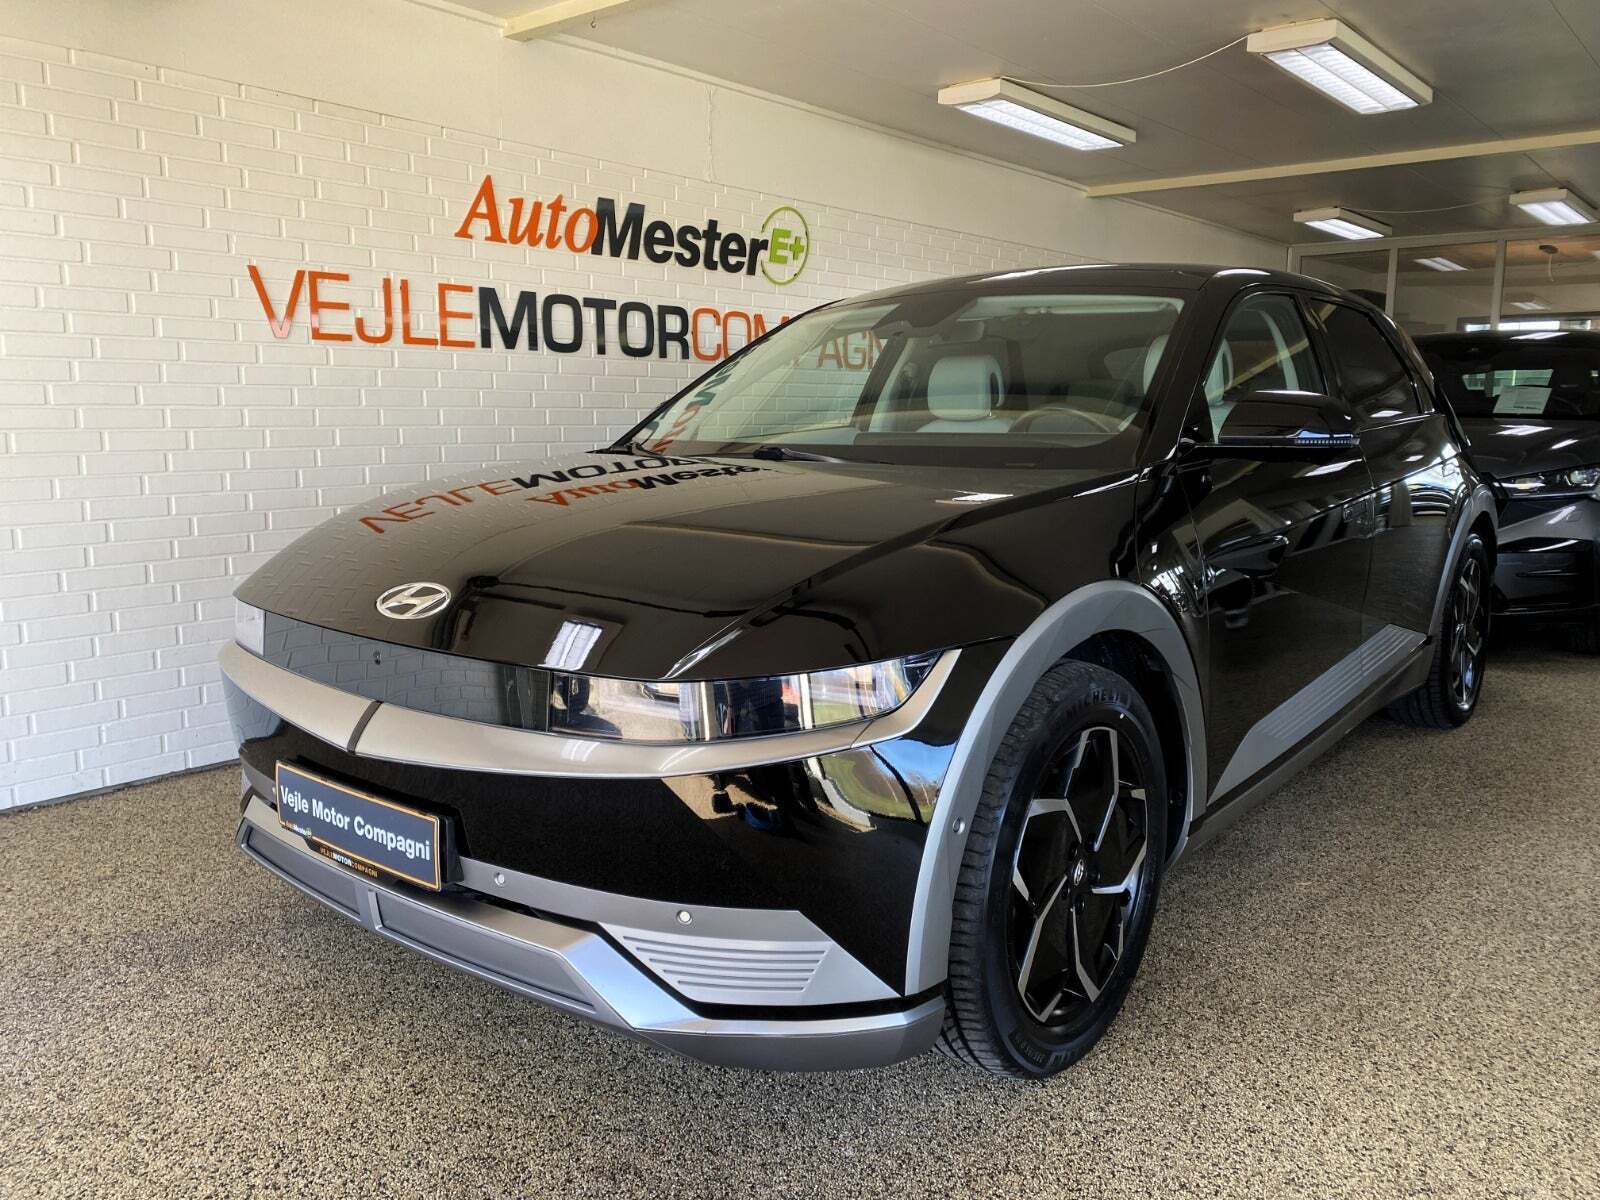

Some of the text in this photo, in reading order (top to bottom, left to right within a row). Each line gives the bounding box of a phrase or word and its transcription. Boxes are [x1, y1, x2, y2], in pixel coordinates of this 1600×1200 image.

[455, 174, 768, 276] AutoMester
[280, 786, 309, 813] Vejle
[312, 798, 350, 830] Motor
[354, 816, 430, 860] Compagni
